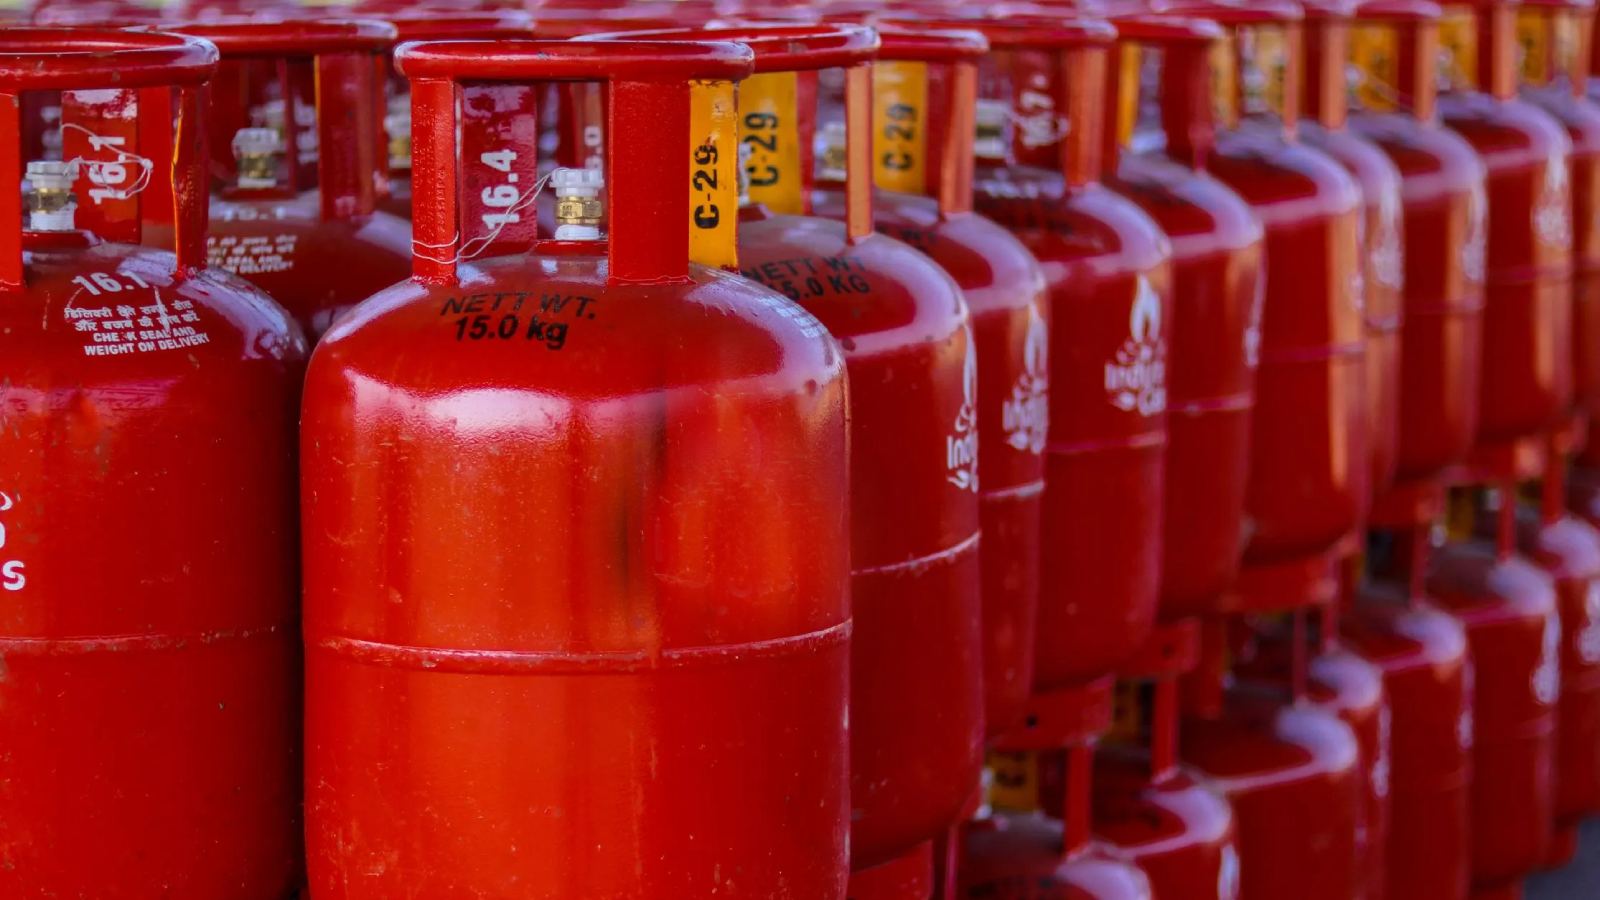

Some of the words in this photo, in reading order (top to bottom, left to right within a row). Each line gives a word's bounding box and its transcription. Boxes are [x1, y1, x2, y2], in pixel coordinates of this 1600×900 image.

[742, 111, 779, 187] C-29
[88, 136, 125, 205] 16.1
[481, 149, 521, 230] 16.4
[692, 143, 720, 230] C-29
[72, 272, 149, 296] 16.1
[768, 277, 824, 300] 5.0
[827, 274, 871, 294] KG
[440, 291, 532, 316] NETT
[84, 342, 135, 356] WEIGHT
[158, 333, 210, 350] DELIVERY
[93, 331, 138, 344] CHEK
[140, 329, 172, 341] SEAL
[173, 326, 196, 338] AND
[455, 314, 519, 342] 15.0
[526, 315, 568, 351] kg
